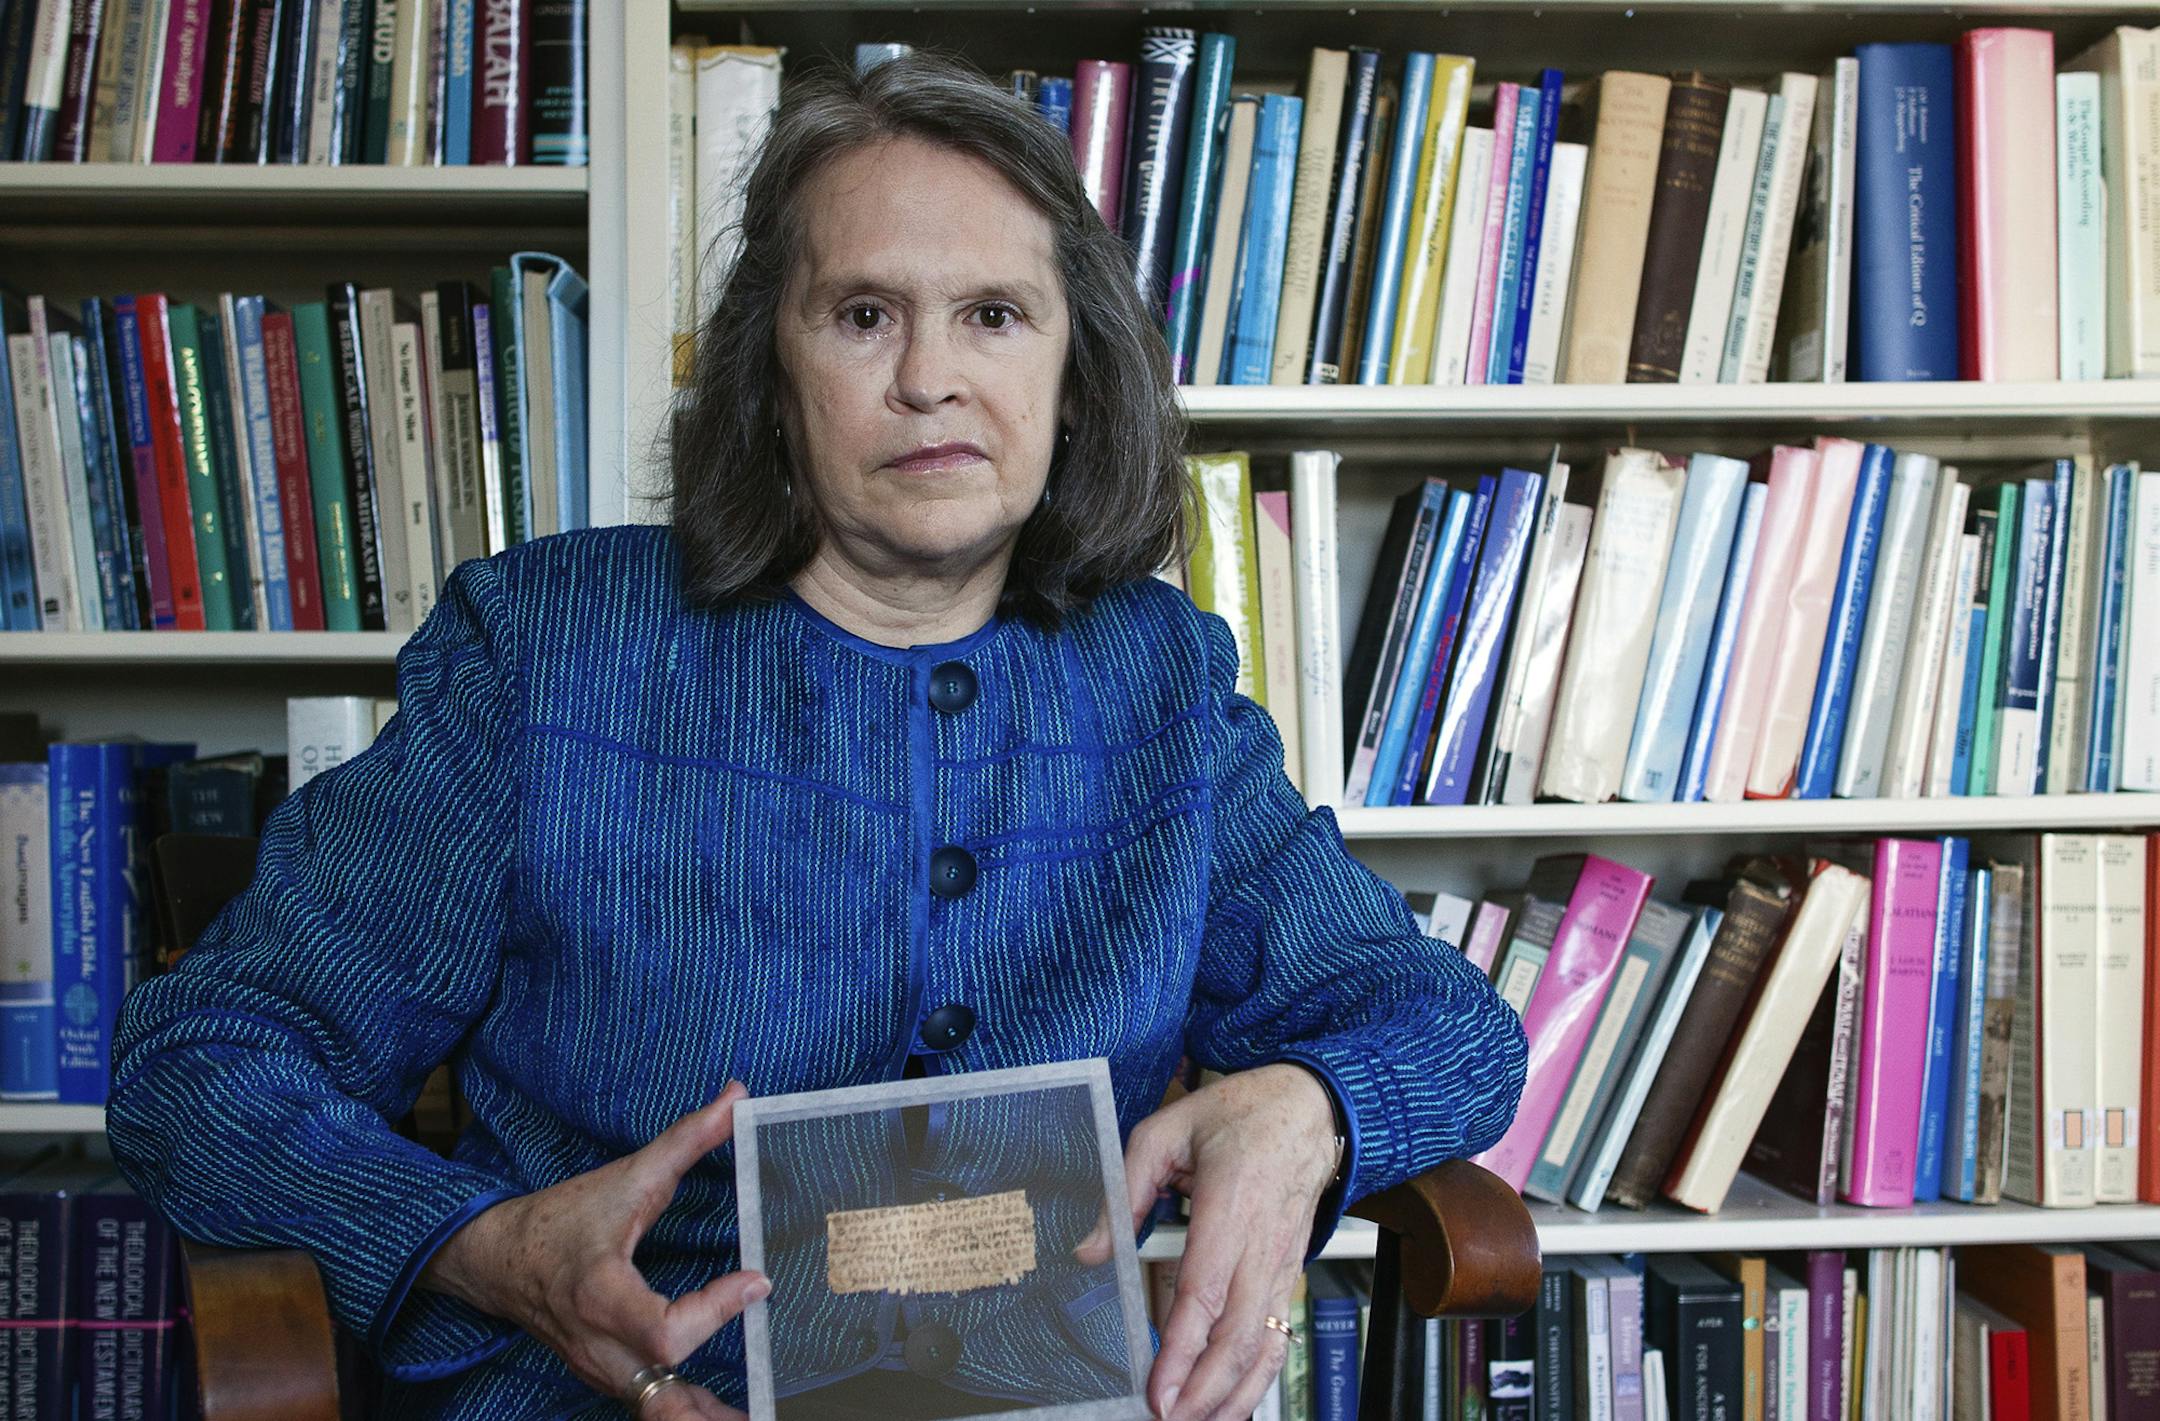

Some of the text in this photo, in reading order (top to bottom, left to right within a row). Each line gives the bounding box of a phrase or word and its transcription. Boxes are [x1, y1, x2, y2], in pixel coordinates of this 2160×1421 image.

[1355, 66, 1375, 114] FARMER
[2079, 99, 2092, 225] The Gospel According
[1908, 167, 1927, 327] The Critical Edition of Q
[338, 320, 359, 406] BIBLICAL
[398, 343, 417, 441] No Longer Be Silent
[347, 410, 364, 458] WOMEN
[460, 440, 475, 487] WOMEN
[1470, 495, 1488, 529] Richard
[355, 492, 376, 582] MIDRASH
[1460, 537, 1477, 565] Pervo
[2027, 505, 2051, 659] The Fourth Evangelist
[1444, 615, 1458, 632] The
[1423, 688, 1438, 710] Acts
[77, 788, 96, 979] The New English Bible
[95, 1218, 117, 1239] OF
[17, 1219, 39, 1319] THEOLOGICAL
[95, 1245, 117, 1277] THE
[121, 1220, 145, 1319] THEOLOGICAL
[95, 1280, 117, 1321] NEW
[1787, 1300, 1798, 1322] The
[1330, 1346, 1344, 1369] The
[1696, 1342, 1708, 1371] FOR
[1785, 1326, 1797, 1376] Apostolic
[1713, 1389, 1724, 1402] A
